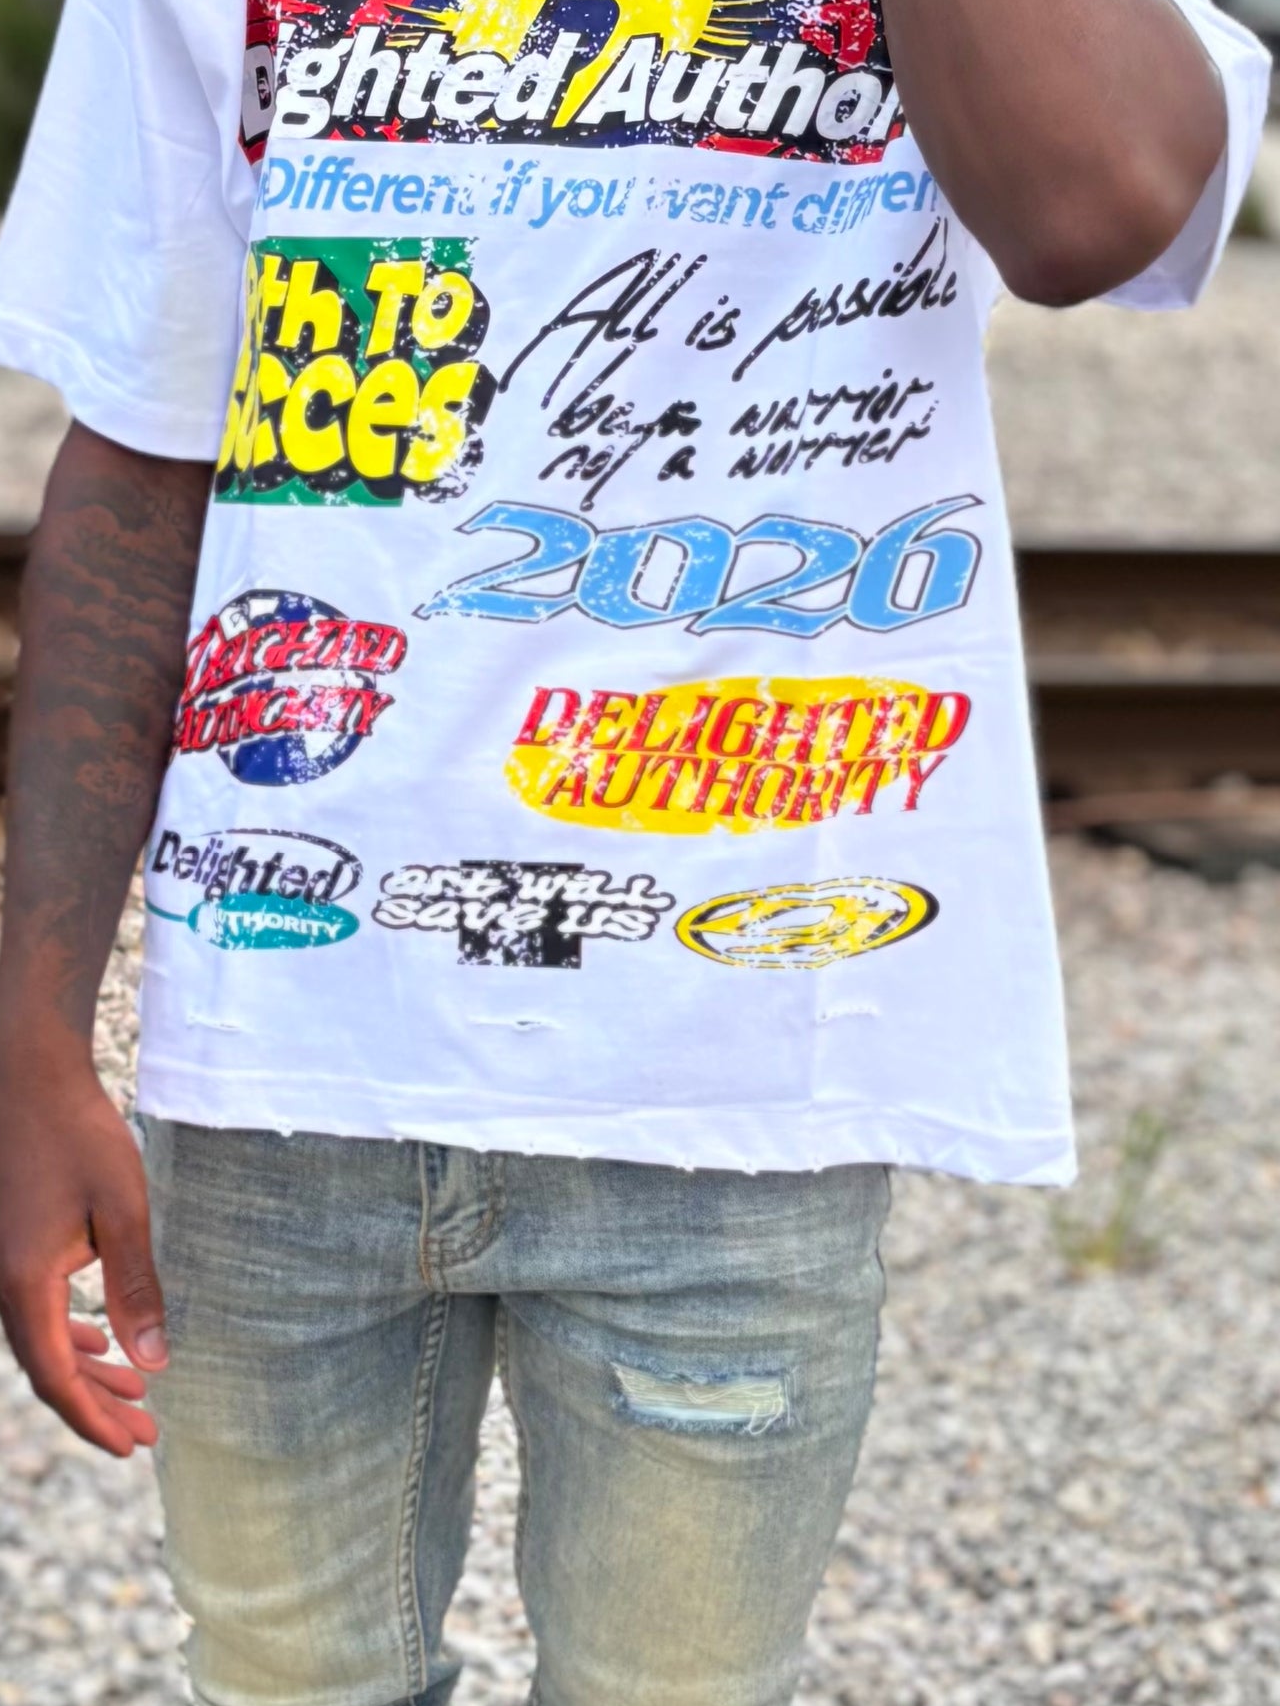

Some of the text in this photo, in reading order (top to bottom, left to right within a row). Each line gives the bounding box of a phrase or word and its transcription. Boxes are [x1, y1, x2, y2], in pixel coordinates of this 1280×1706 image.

[241, 23, 903, 141] Dighted Author
[489, 159, 540, 215] if
[528, 177, 633, 229] you
[499, 248, 708, 410] All
[685, 295, 741, 351] is
[548, 343, 635, 438] be
[729, 368, 934, 437] warrior
[657, 445, 697, 481] a
[412, 495, 985, 639] 2026
[512, 686, 971, 765] DELIGHTED
[542, 752, 948, 822] AUTHORITY
[151, 829, 344, 906] Delighted
[209, 908, 344, 941] THORITY
